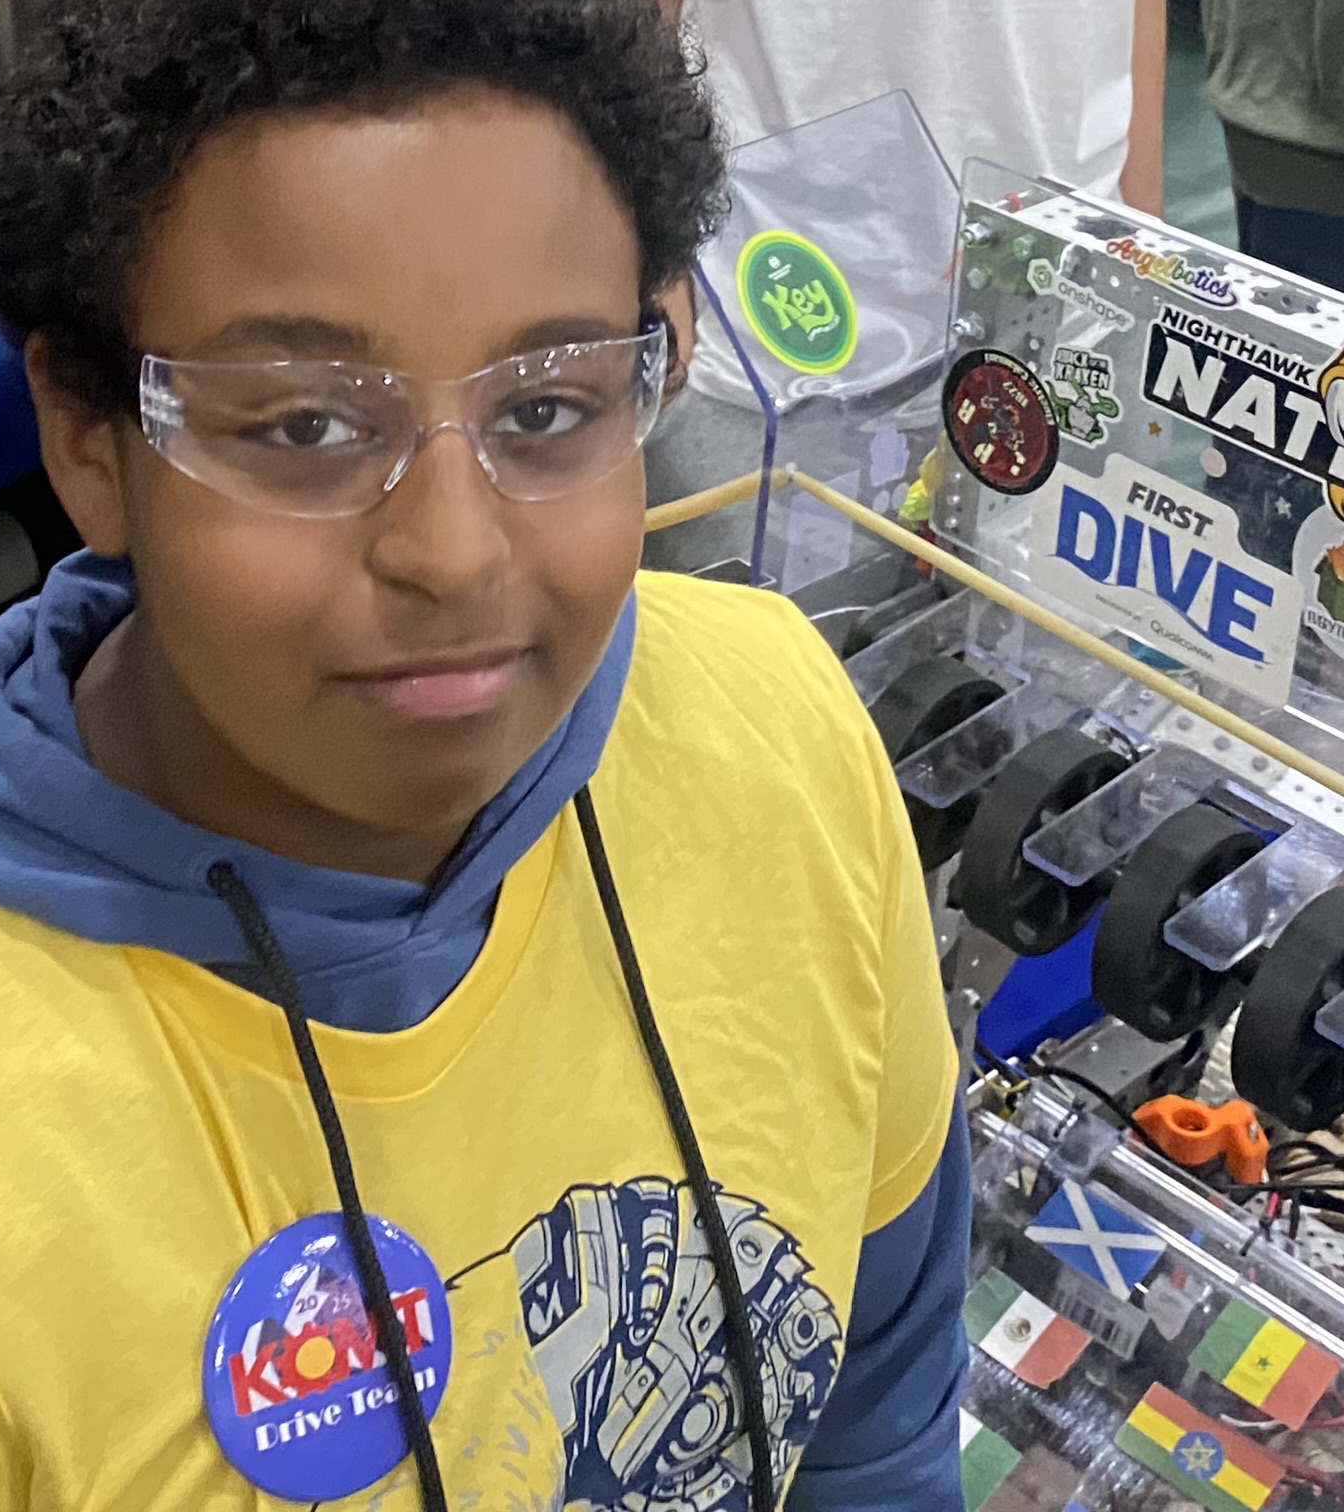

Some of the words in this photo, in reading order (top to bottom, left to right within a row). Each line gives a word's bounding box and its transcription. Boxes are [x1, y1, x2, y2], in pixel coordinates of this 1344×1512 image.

[1107, 238, 1234, 299] Angelbotics
[761, 279, 835, 334] Key
[1057, 281, 1129, 327] onshape
[1162, 306, 1317, 386] NIGHTHAWK
[1126, 481, 1214, 537] FIRST
[1054, 484, 1275, 663] DIVE
[295, 1294, 319, 1314] 20
[331, 1294, 352, 1314] 25
[255, 1402, 343, 1452] Drive
